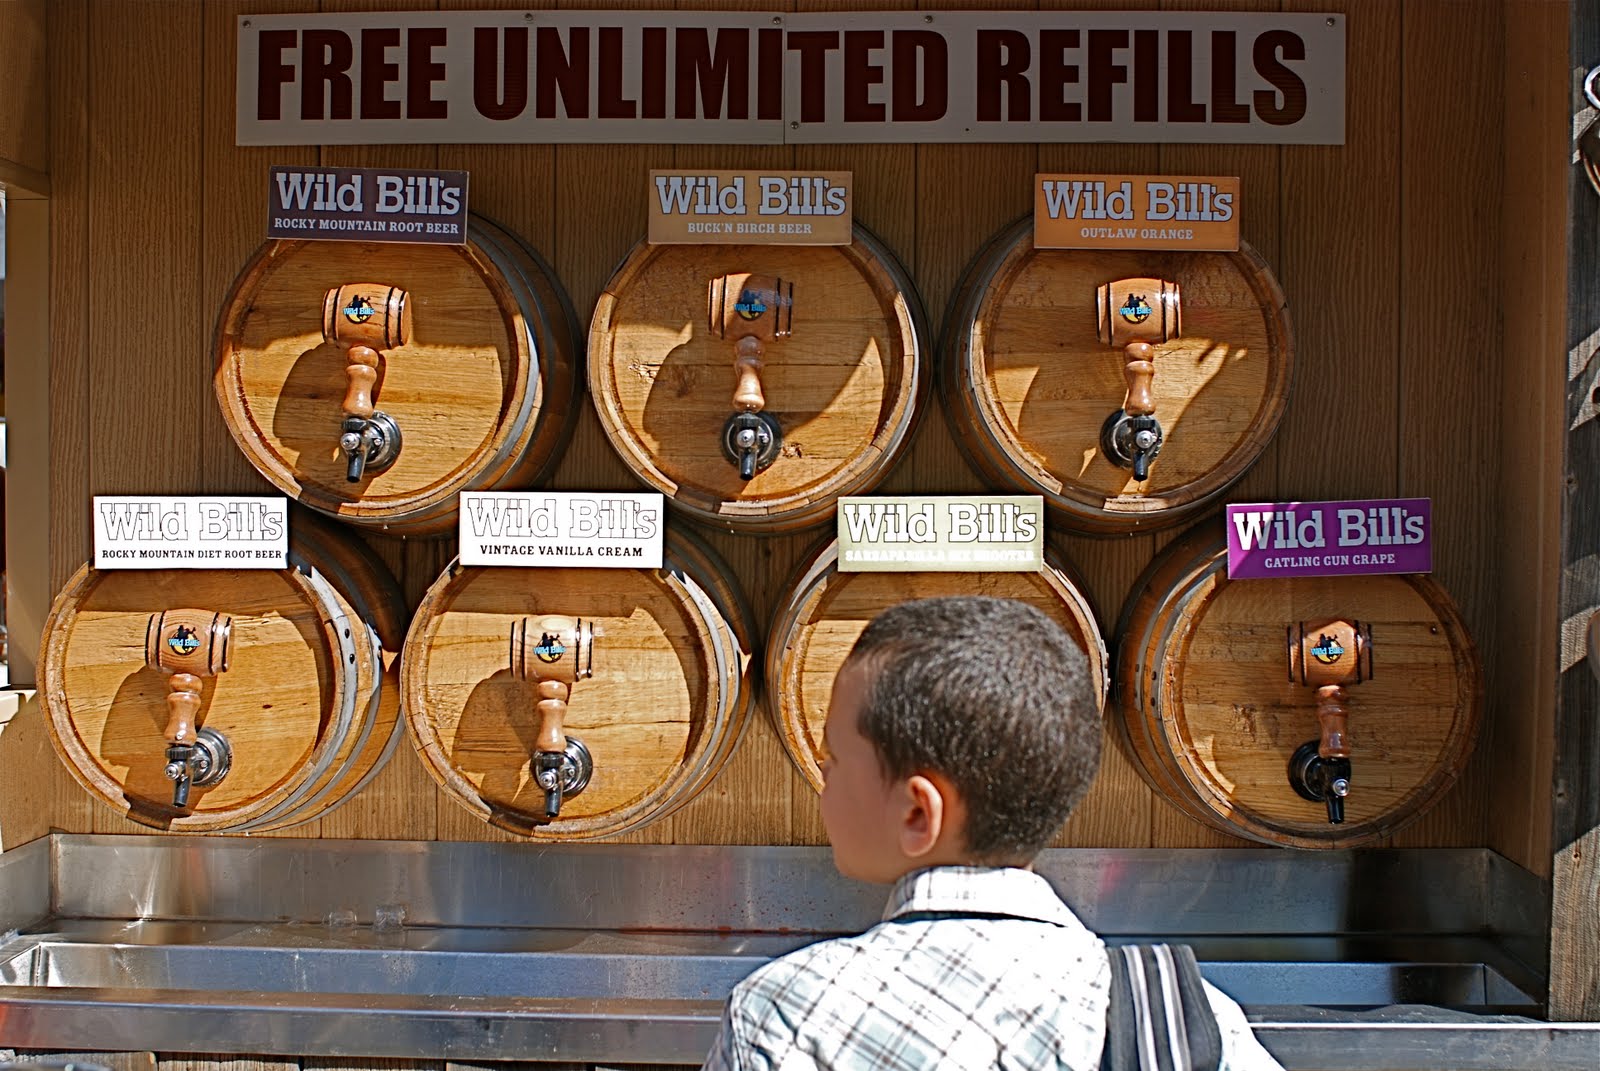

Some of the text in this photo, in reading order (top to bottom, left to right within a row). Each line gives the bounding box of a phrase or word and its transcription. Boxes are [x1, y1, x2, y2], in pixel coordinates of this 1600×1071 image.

[257, 26, 1307, 126] FREE UNLIMITED REFILLS
[275, 172, 461, 215] Wild Bill's
[655, 176, 847, 216] Wild Bill's
[1042, 180, 1233, 222] Wild Bill's
[274, 217, 459, 234] ROCKY MOUNTAIN ROOT BEER
[687, 222, 812, 234] BUCK'N BIRCH BEER
[1080, 227, 1193, 240] OUTLAW ORANGE
[100, 502, 283, 541] Wild Bill's
[467, 497, 657, 539] Wild Bill's
[843, 503, 1037, 543] Wild Bill's
[1233, 507, 1425, 551] Wild Bill's
[102, 550, 282, 559] ROCKY MOUNTAIN DIET ROOT BEER
[480, 545, 643, 557] VINTAGE VANILLA CREAM
[1264, 554, 1395, 569] GATLING GUN GRAPE
